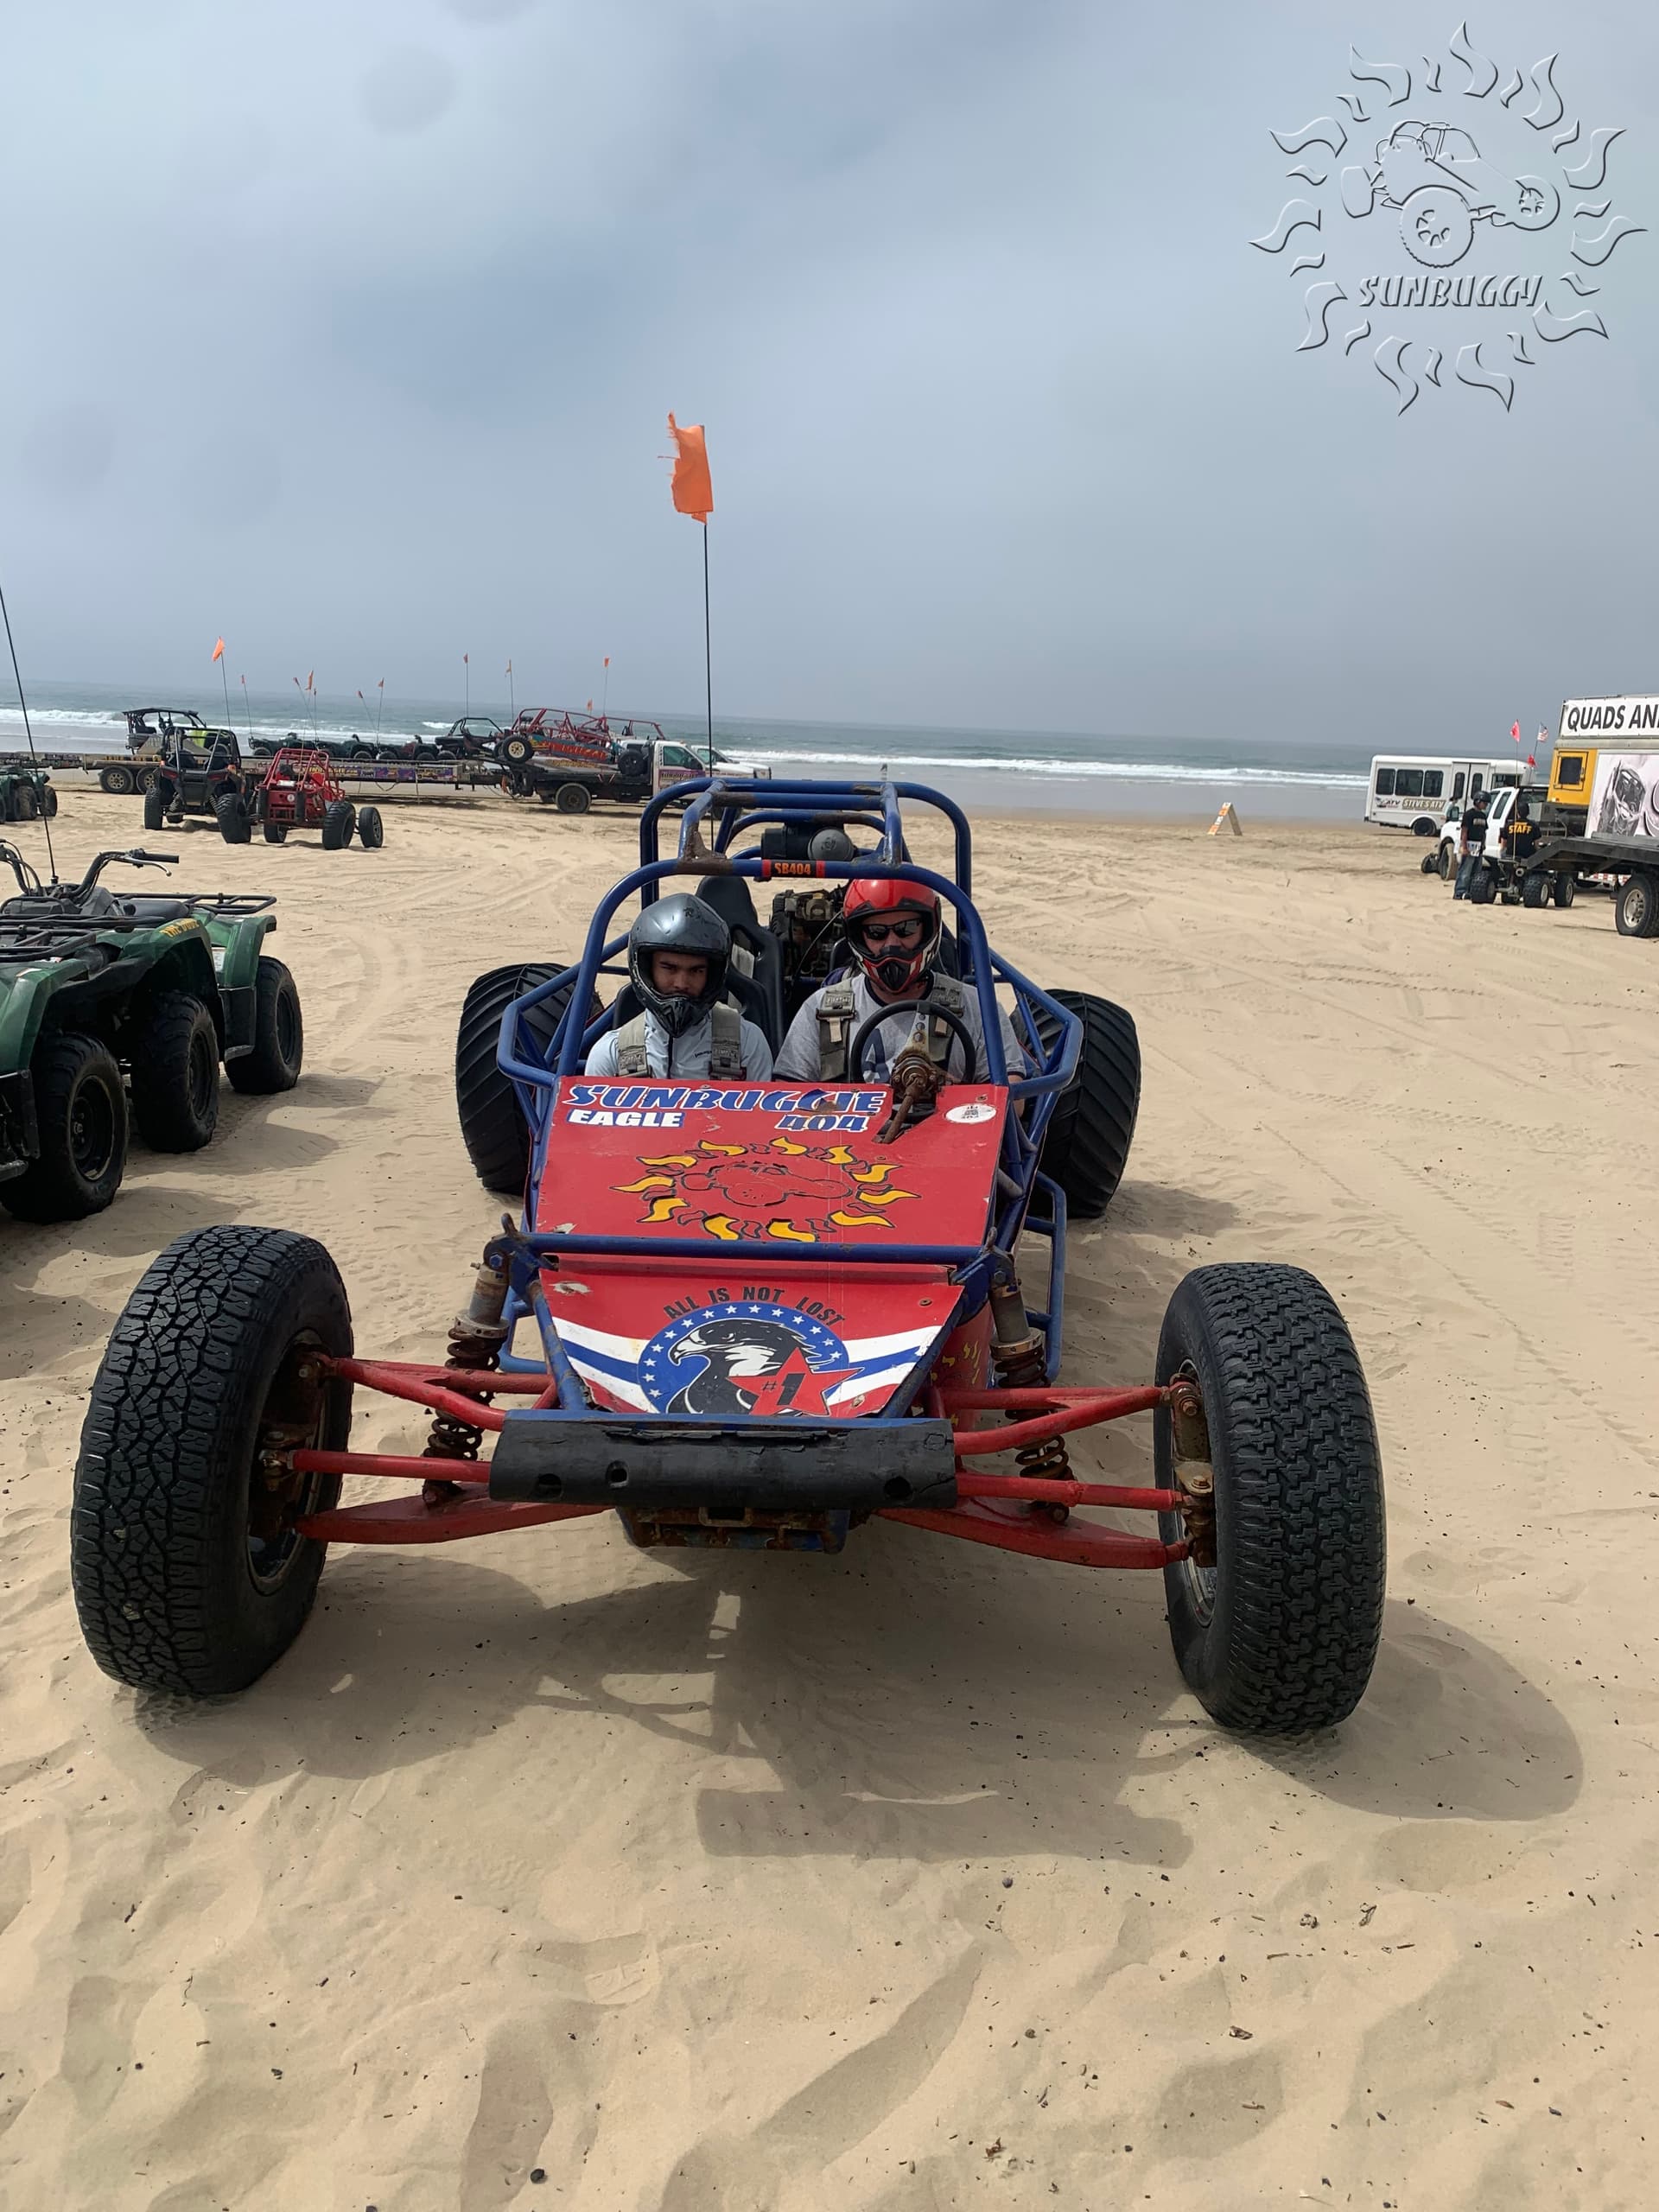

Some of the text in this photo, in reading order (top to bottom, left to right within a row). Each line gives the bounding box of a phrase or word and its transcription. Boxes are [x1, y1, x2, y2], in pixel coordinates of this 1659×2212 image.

[1567, 703, 1659, 732] QUADS AN
[1508, 823, 1533, 835] STAFF
[774, 862, 811, 875] SB404
[563, 1084, 886, 1114] SUNBUGGIE
[568, 1109, 868, 1132] EAGLE 404
[664, 1286, 845, 1326] ALL IS NOT LOST
